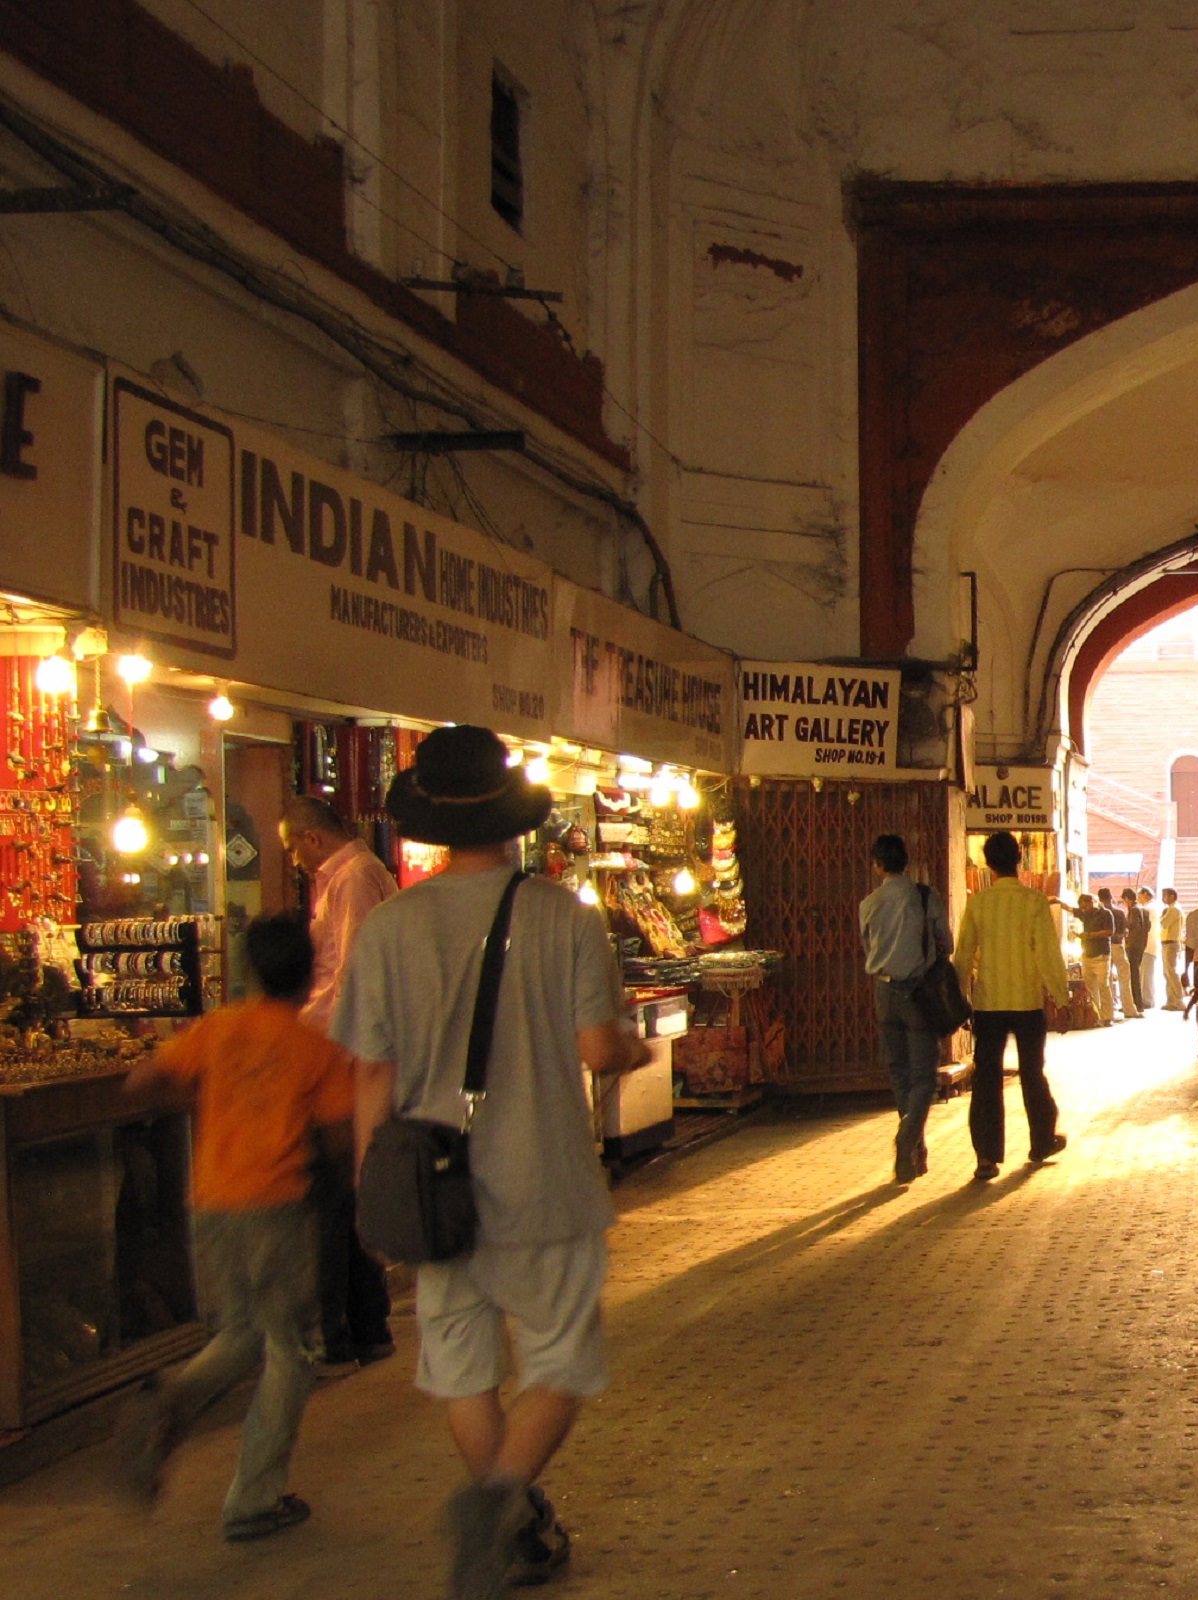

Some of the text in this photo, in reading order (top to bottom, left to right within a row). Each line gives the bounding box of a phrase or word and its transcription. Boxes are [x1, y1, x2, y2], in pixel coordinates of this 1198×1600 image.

[145, 419, 204, 488] GEM
[170, 488, 188, 513] &
[127, 506, 219, 579] CRAFT
[241, 449, 549, 642] INDIAN HOME INDUSTRIES
[121, 561, 229, 636] INDUSTRIES
[331, 583, 428, 647] MANUFACTURERS
[682, 674, 722, 734] HOUSE
[742, 671, 890, 709] HIMALAYAN
[744, 713, 890, 748] ART GALLERY
[815, 748, 846, 763] SHOP
[985, 813, 1013, 824] SHOP
